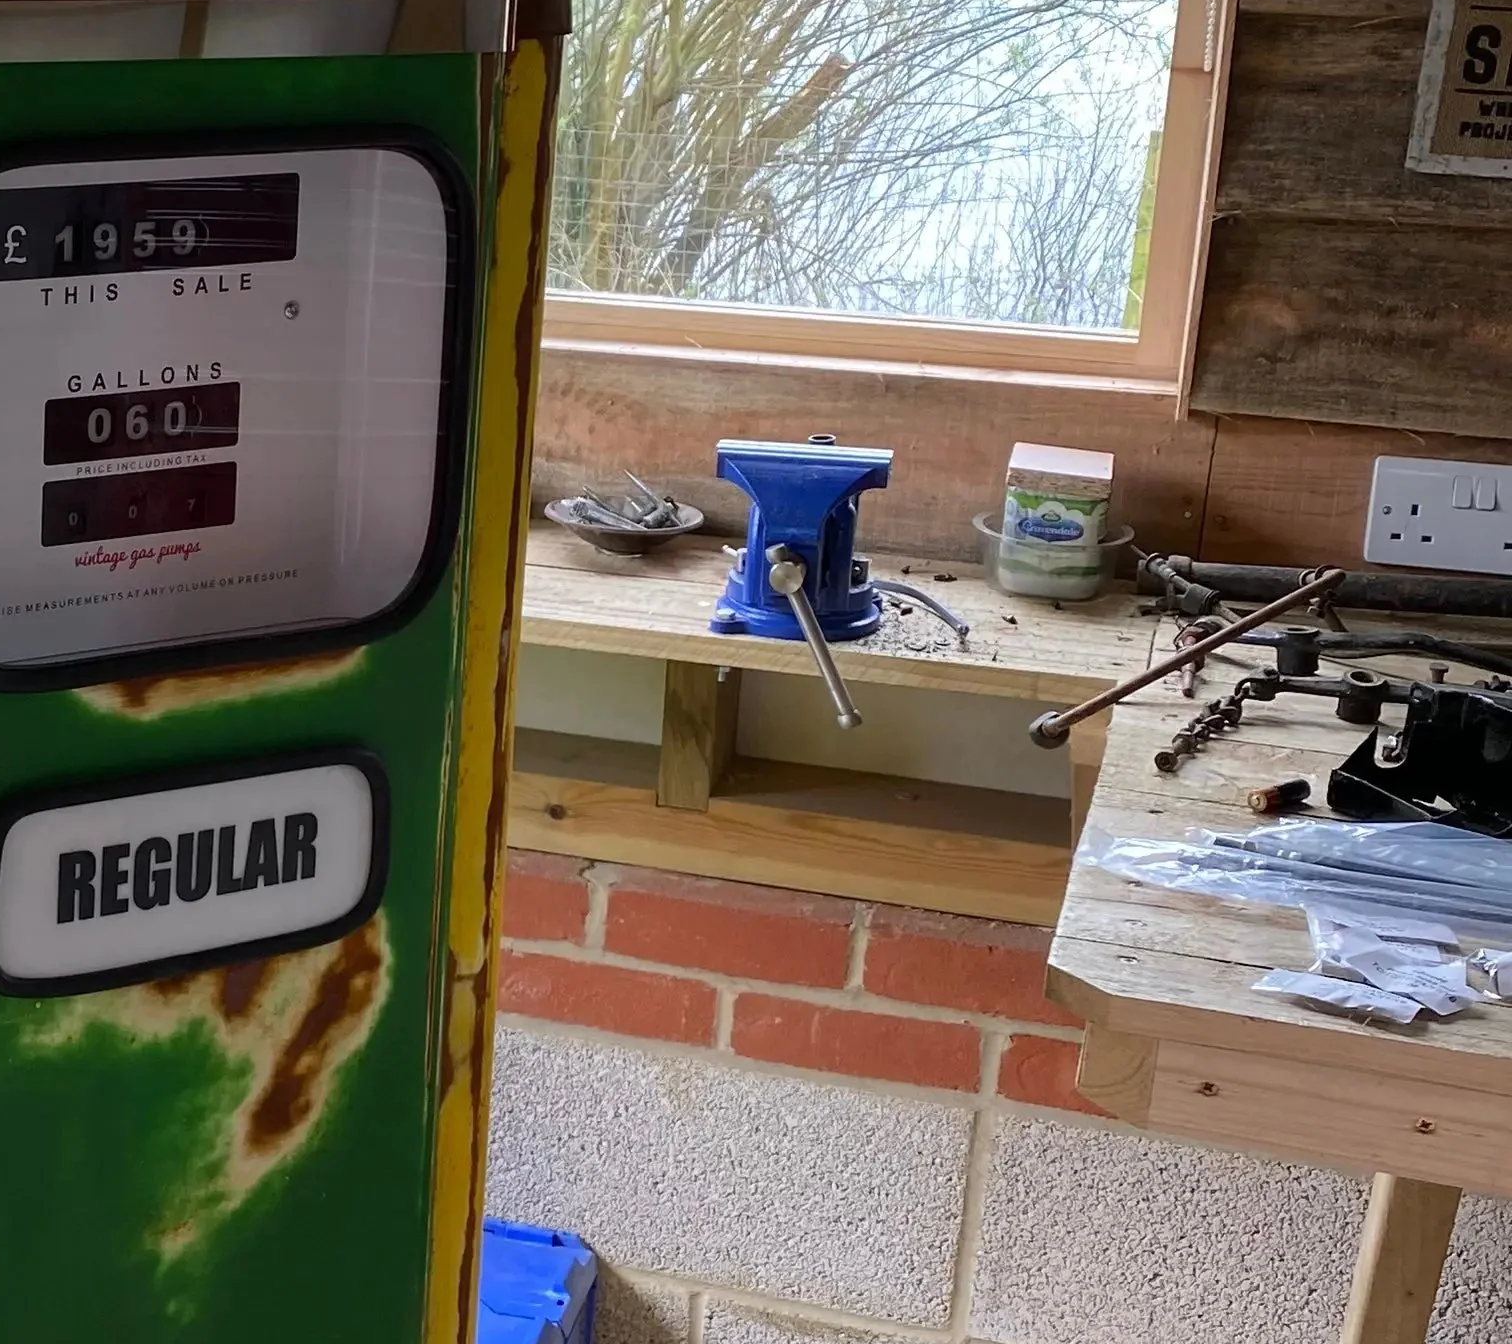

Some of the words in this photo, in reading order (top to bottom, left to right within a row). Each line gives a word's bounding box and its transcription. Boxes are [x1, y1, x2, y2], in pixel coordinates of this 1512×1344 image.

[4, 225, 28, 264] £
[54, 219, 197, 263] 1959
[40, 283, 119, 306] THIS
[172, 273, 252, 296] SALE
[67, 362, 222, 393] GALLONS
[88, 401, 187, 444] 060
[76, 463, 113, 476] PRICE
[116, 456, 183, 472] INCLUDING
[187, 455, 207, 464] TAX
[75, 545, 128, 572] vintage
[129, 547, 156, 570] gas
[157, 541, 202, 564] pumps
[25, 593, 124, 613] MEASUREMENTS
[126, 589, 141, 600] AT
[143, 587, 166, 598] ANY
[169, 579, 216, 594] VOLUME
[238, 569, 299, 585] PRESSURE
[57, 812, 319, 925] REGULAR
